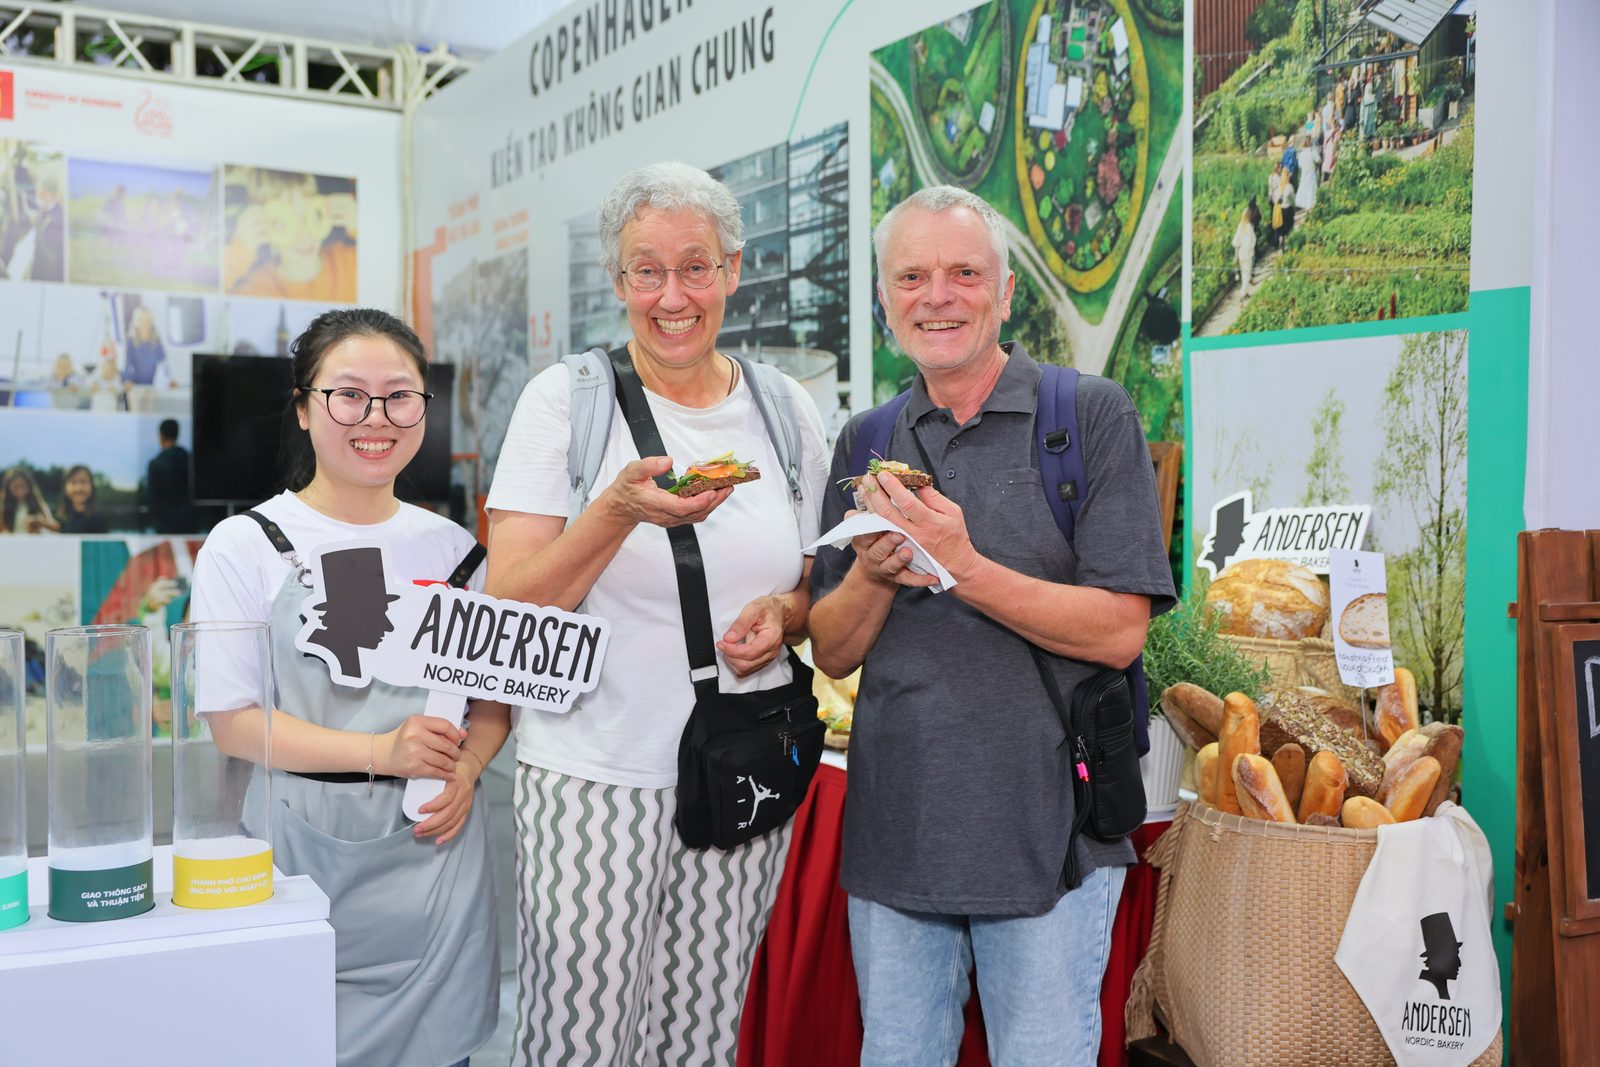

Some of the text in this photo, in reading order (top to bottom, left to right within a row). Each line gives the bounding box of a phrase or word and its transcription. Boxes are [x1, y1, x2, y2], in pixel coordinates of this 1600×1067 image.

[529, 0, 692, 97] COPENHAG
[528, 120, 558, 181] TẠO
[563, 90, 624, 157] KHÔNG
[632, 55, 681, 123] GIAN
[692, 6, 775, 96] CHUNG
[1252, 511, 1364, 552] ANDERSEN
[1299, 556, 1330, 569] BAKE
[410, 593, 602, 684] ANDERSEN
[423, 662, 571, 705] NORDIC BAKERY
[736, 774, 748, 830] AIR
[81, 891, 102, 899] GIAO
[103, 887, 132, 898] THÔNG
[86, 899, 99, 908] VÀ
[100, 896, 129, 907] THUẬN
[1401, 1001, 1471, 1037] ANDERSEN
[1405, 1036, 1465, 1051] NORDIC BAKERY
